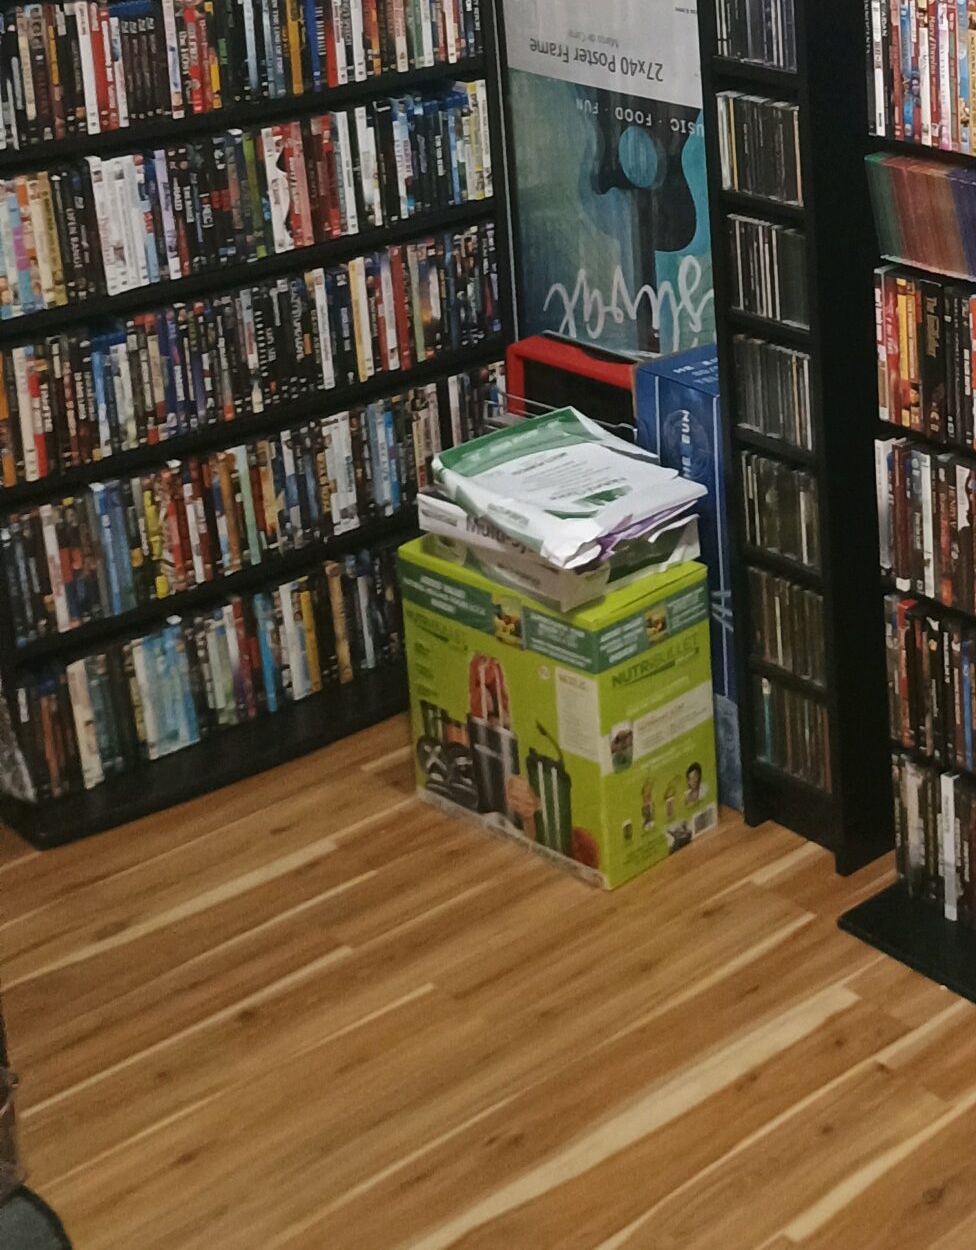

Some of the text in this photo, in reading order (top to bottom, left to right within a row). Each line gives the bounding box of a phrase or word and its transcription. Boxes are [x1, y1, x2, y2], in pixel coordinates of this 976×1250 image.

[530, 38, 570, 63] Frame
[573, 48, 616, 72] Poster
[621, 56, 664, 82] 27x40
[614, 107, 652, 126] FOOD
